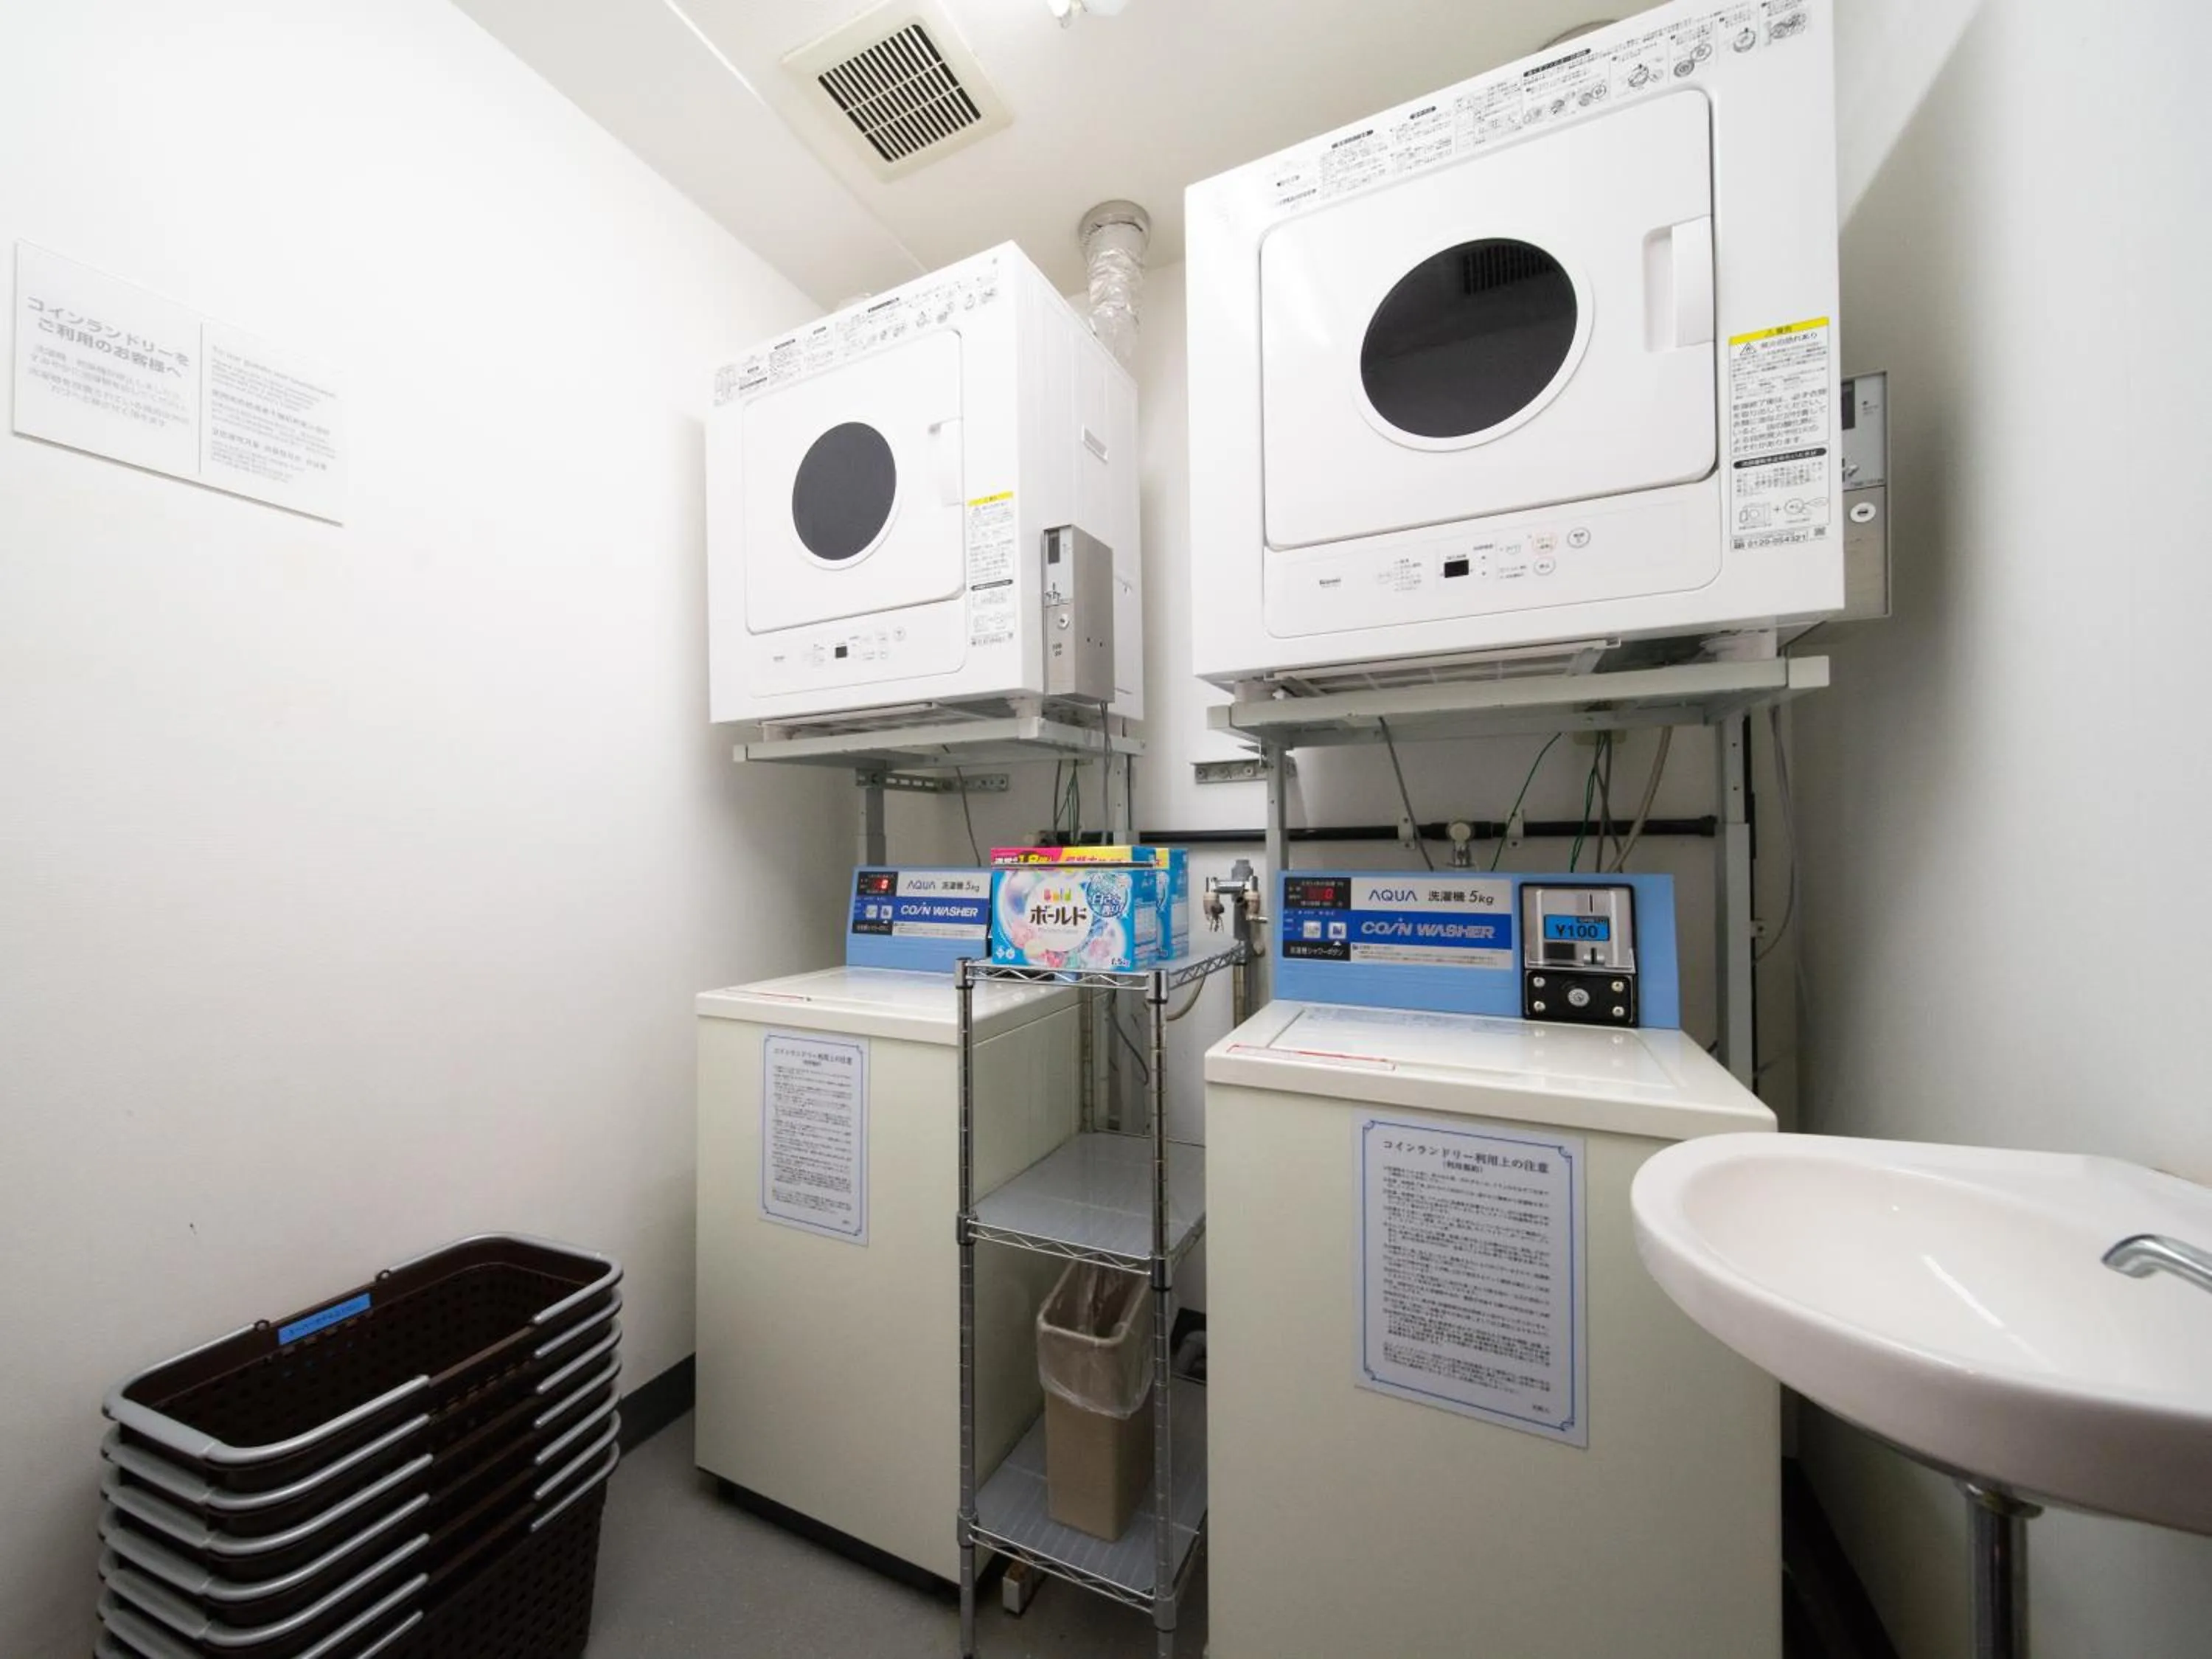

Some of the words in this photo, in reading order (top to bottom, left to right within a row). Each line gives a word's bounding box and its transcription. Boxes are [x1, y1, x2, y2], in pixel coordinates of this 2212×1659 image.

[27, 296, 189, 367] コインランドリーを
[38, 316, 182, 378] ご利用のお客様へ
[906, 880, 936, 891] AQUA
[1368, 889, 1418, 902] AQUA
[1427, 890, 1465, 902] 洗濯機
[1469, 890, 1495, 905] 5kg
[933, 906, 978, 917] WASHER
[1029, 905, 1088, 926] ボールド
[1416, 923, 1496, 939] WASHER
[1382, 1139, 1549, 1174] コインランドリー利用上の注意
